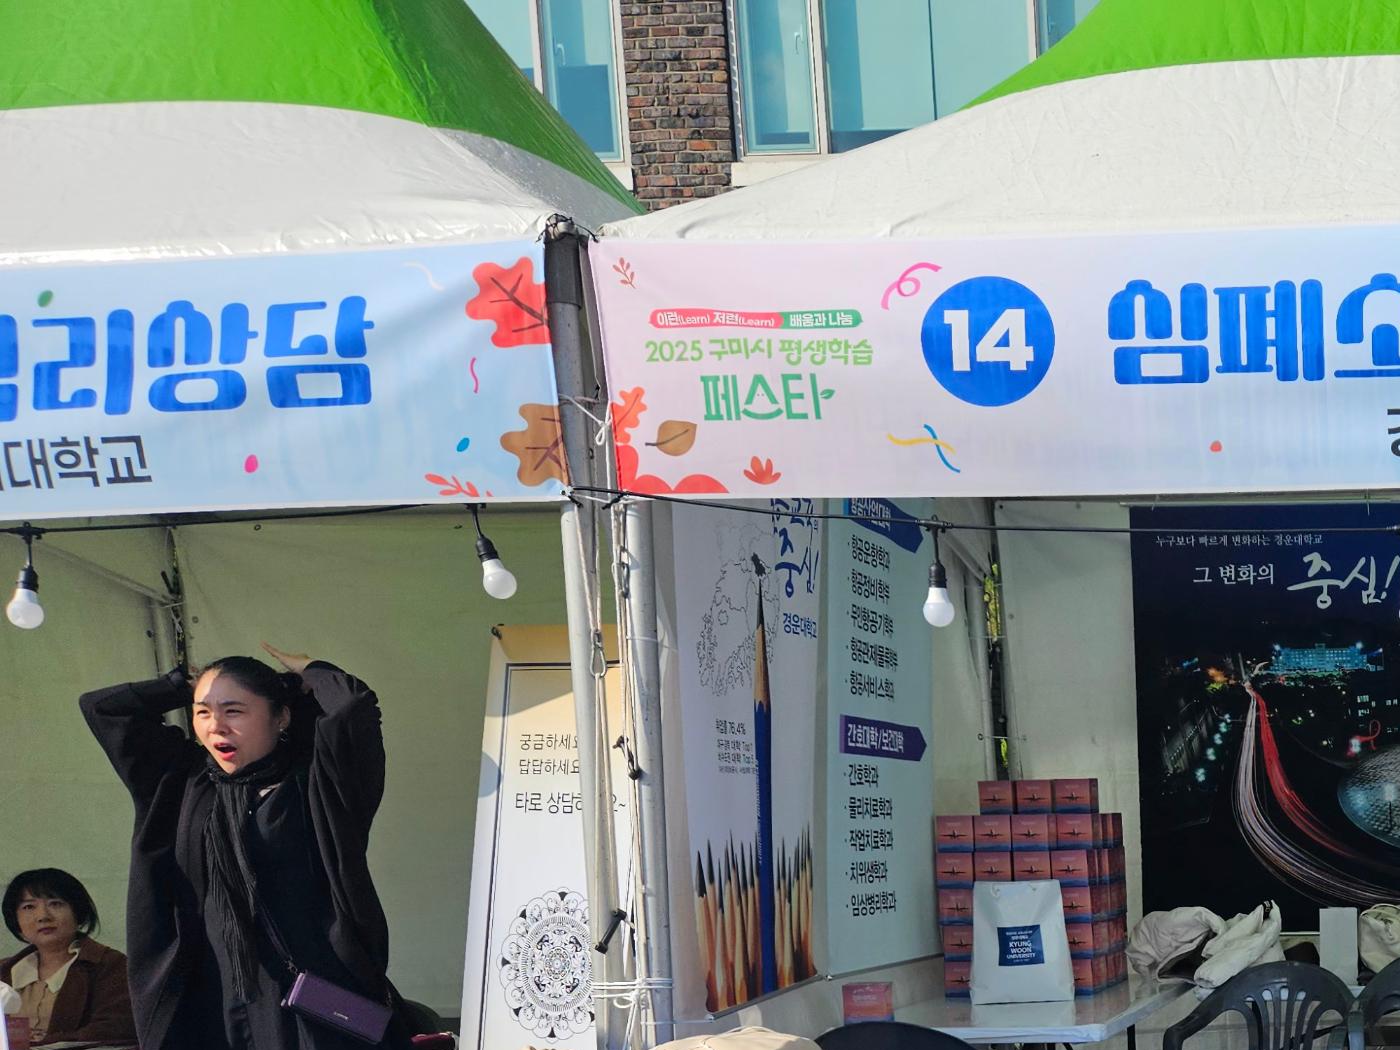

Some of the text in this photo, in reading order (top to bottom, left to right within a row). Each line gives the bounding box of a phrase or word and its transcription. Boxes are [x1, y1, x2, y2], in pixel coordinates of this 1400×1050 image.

[790, 313, 826, 327] 배움과
[828, 312, 853, 327] 나눔
[645, 338, 873, 366] 2025 구미시 평생학습
[943, 309, 1034, 372] 14
[0, 296, 374, 422] 리상담
[700, 373, 835, 421] 페스타
[0, 434, 152, 490] 대학교
[1156, 534, 1323, 547] 누구보다 빠르게 변화하는 경운대학교
[1193, 552, 1400, 609] 그 변화의 중심!
[783, 612, 817, 639] 경운대학교
[848, 764, 878, 787] 간호학과
[515, 792, 542, 813] 타로
[848, 797, 892, 819] 물리치료학과
[849, 829, 893, 851] 작업치료학과
[850, 861, 887, 884] 치위생학과
[851, 891, 896, 917] 임상병리학과
